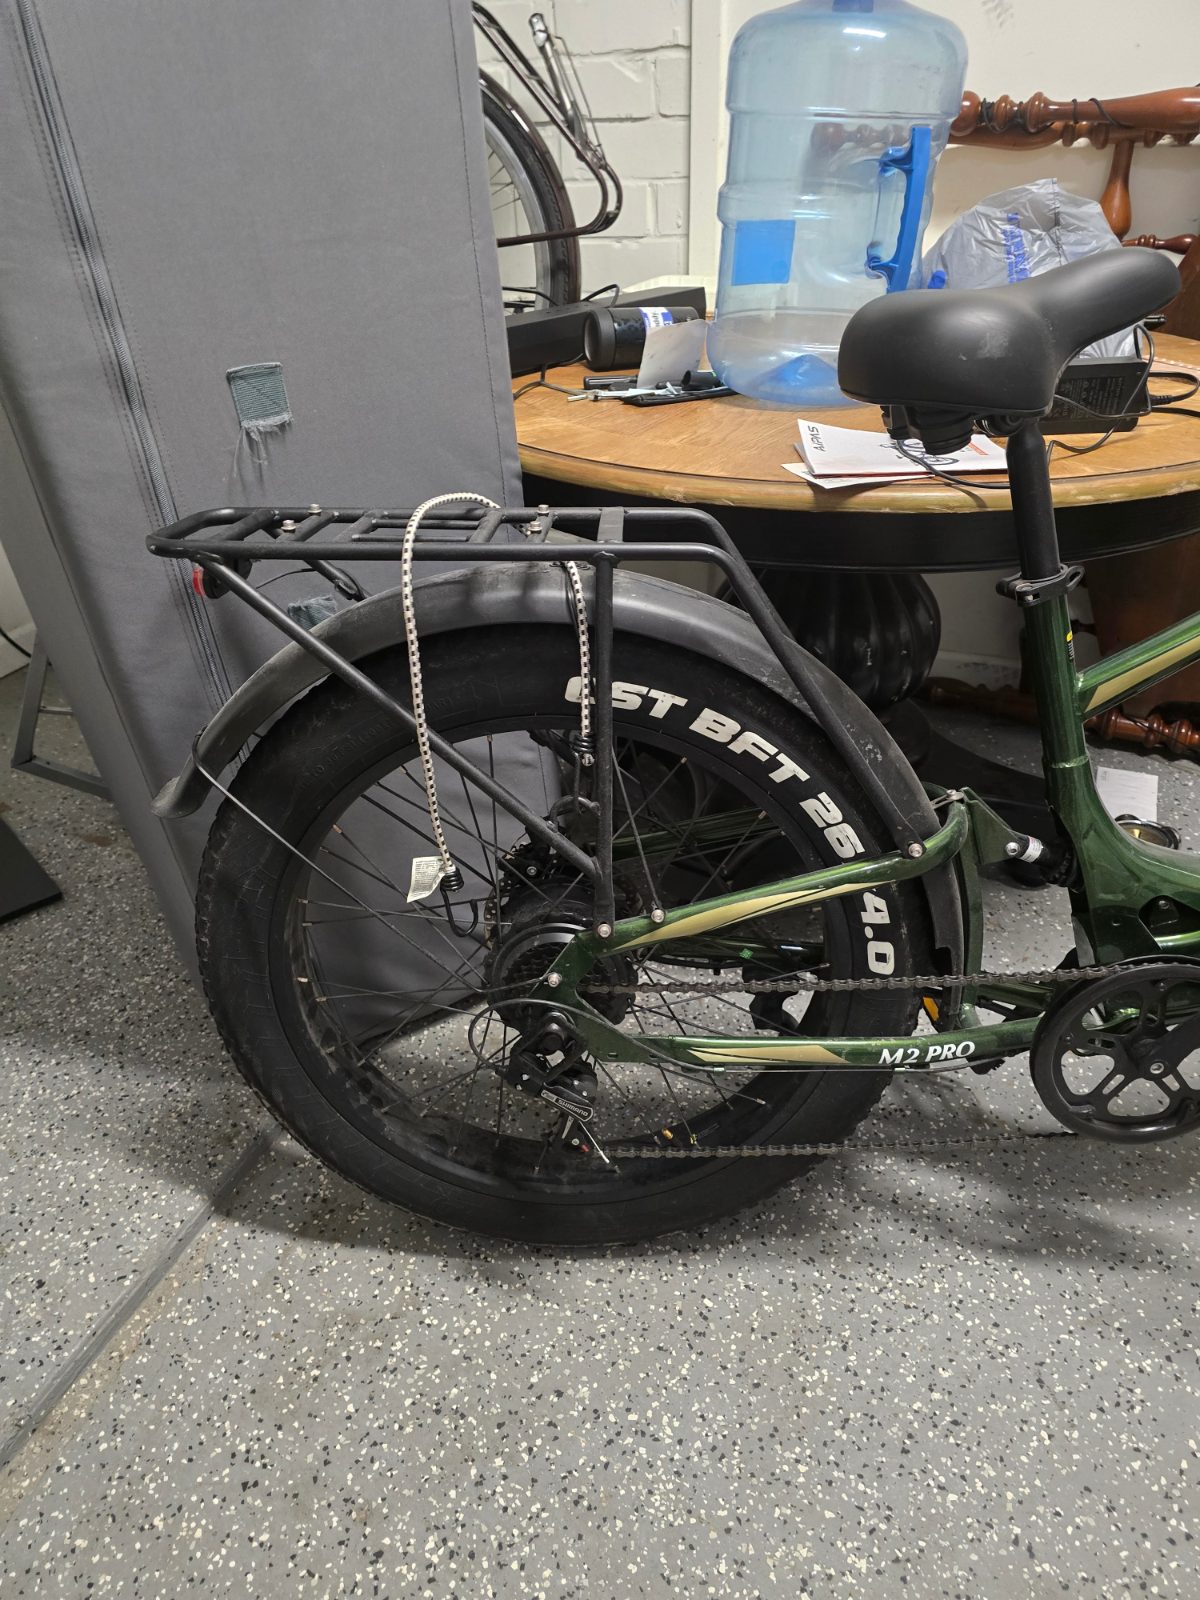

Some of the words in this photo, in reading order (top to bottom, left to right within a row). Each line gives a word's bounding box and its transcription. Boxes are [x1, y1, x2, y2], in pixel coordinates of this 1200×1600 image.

[688, 706, 811, 784] BFT
[798, 790, 866, 860] 26
[878, 1047, 920, 1065] M2
[924, 1040, 976, 1063] PRO
[557, 1098, 589, 1117] SHIMANO
